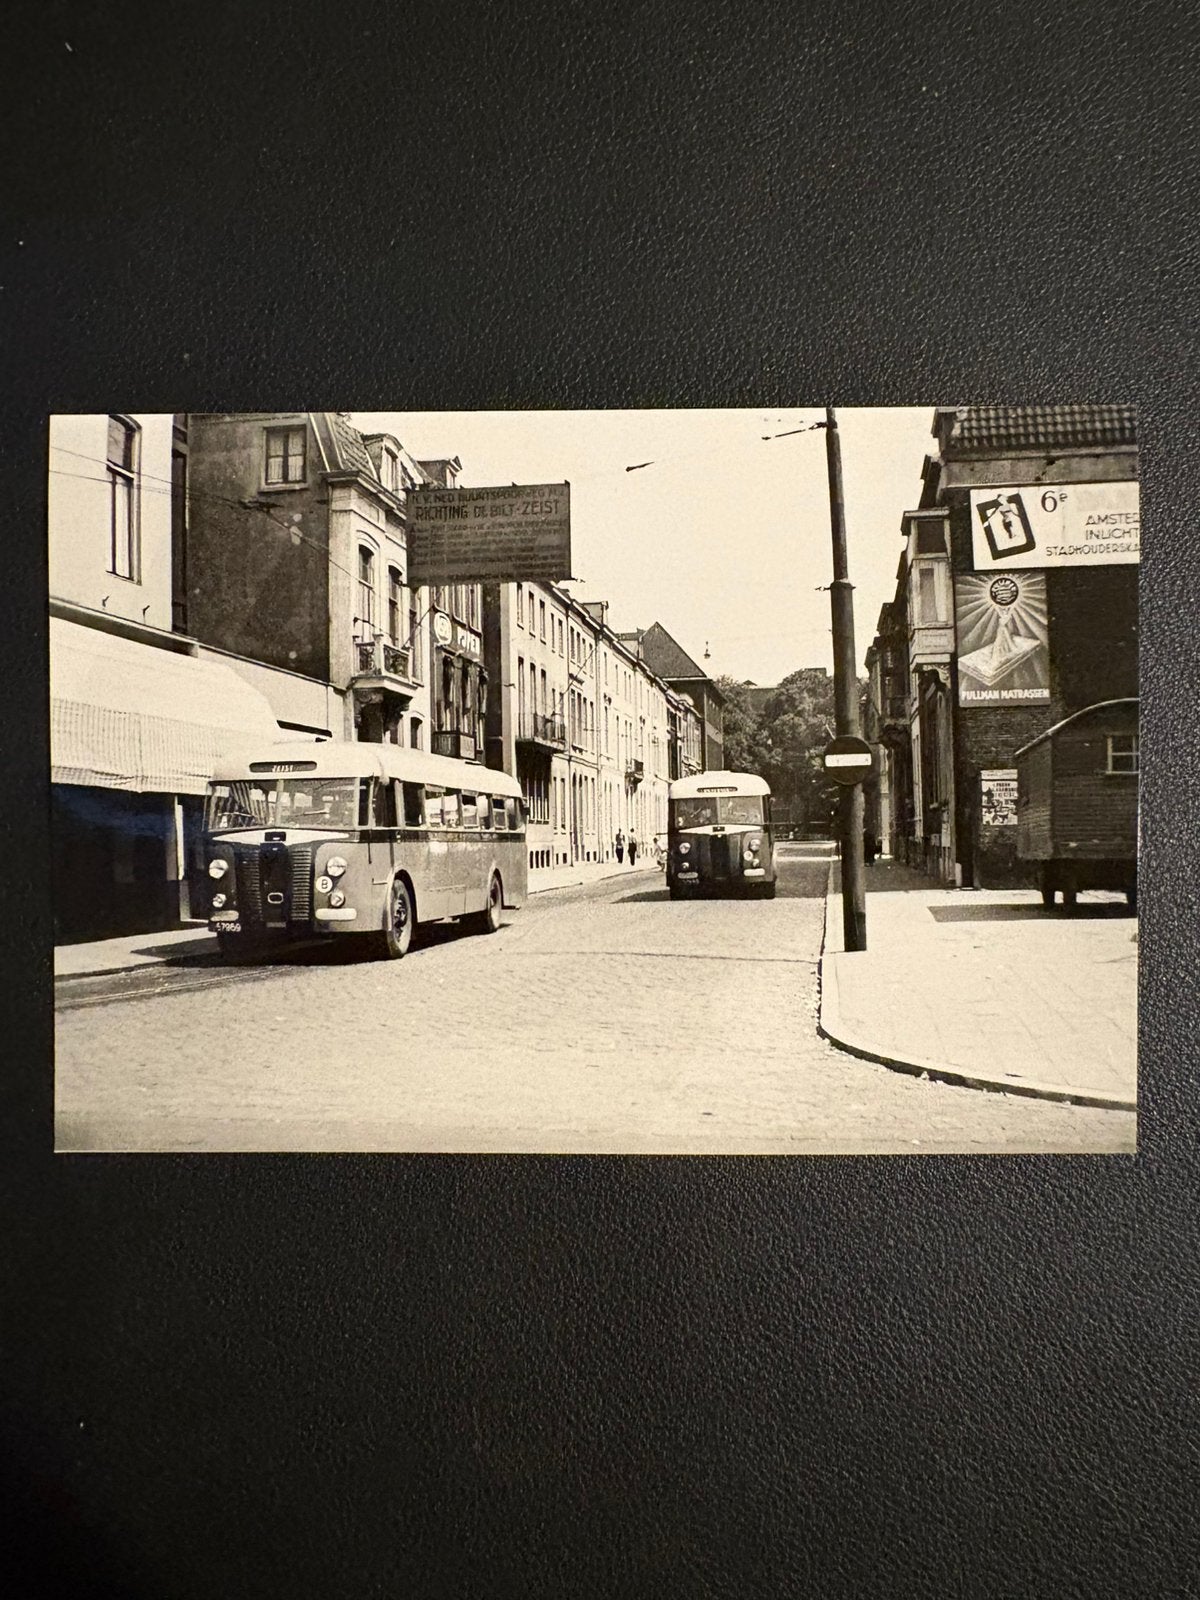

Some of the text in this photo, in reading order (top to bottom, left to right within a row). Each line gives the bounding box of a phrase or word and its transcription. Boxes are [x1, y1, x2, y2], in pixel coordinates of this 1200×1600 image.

[416, 505, 469, 521] RICHTING
[961, 688, 1050, 701] PULLMAN MATRASSEN
